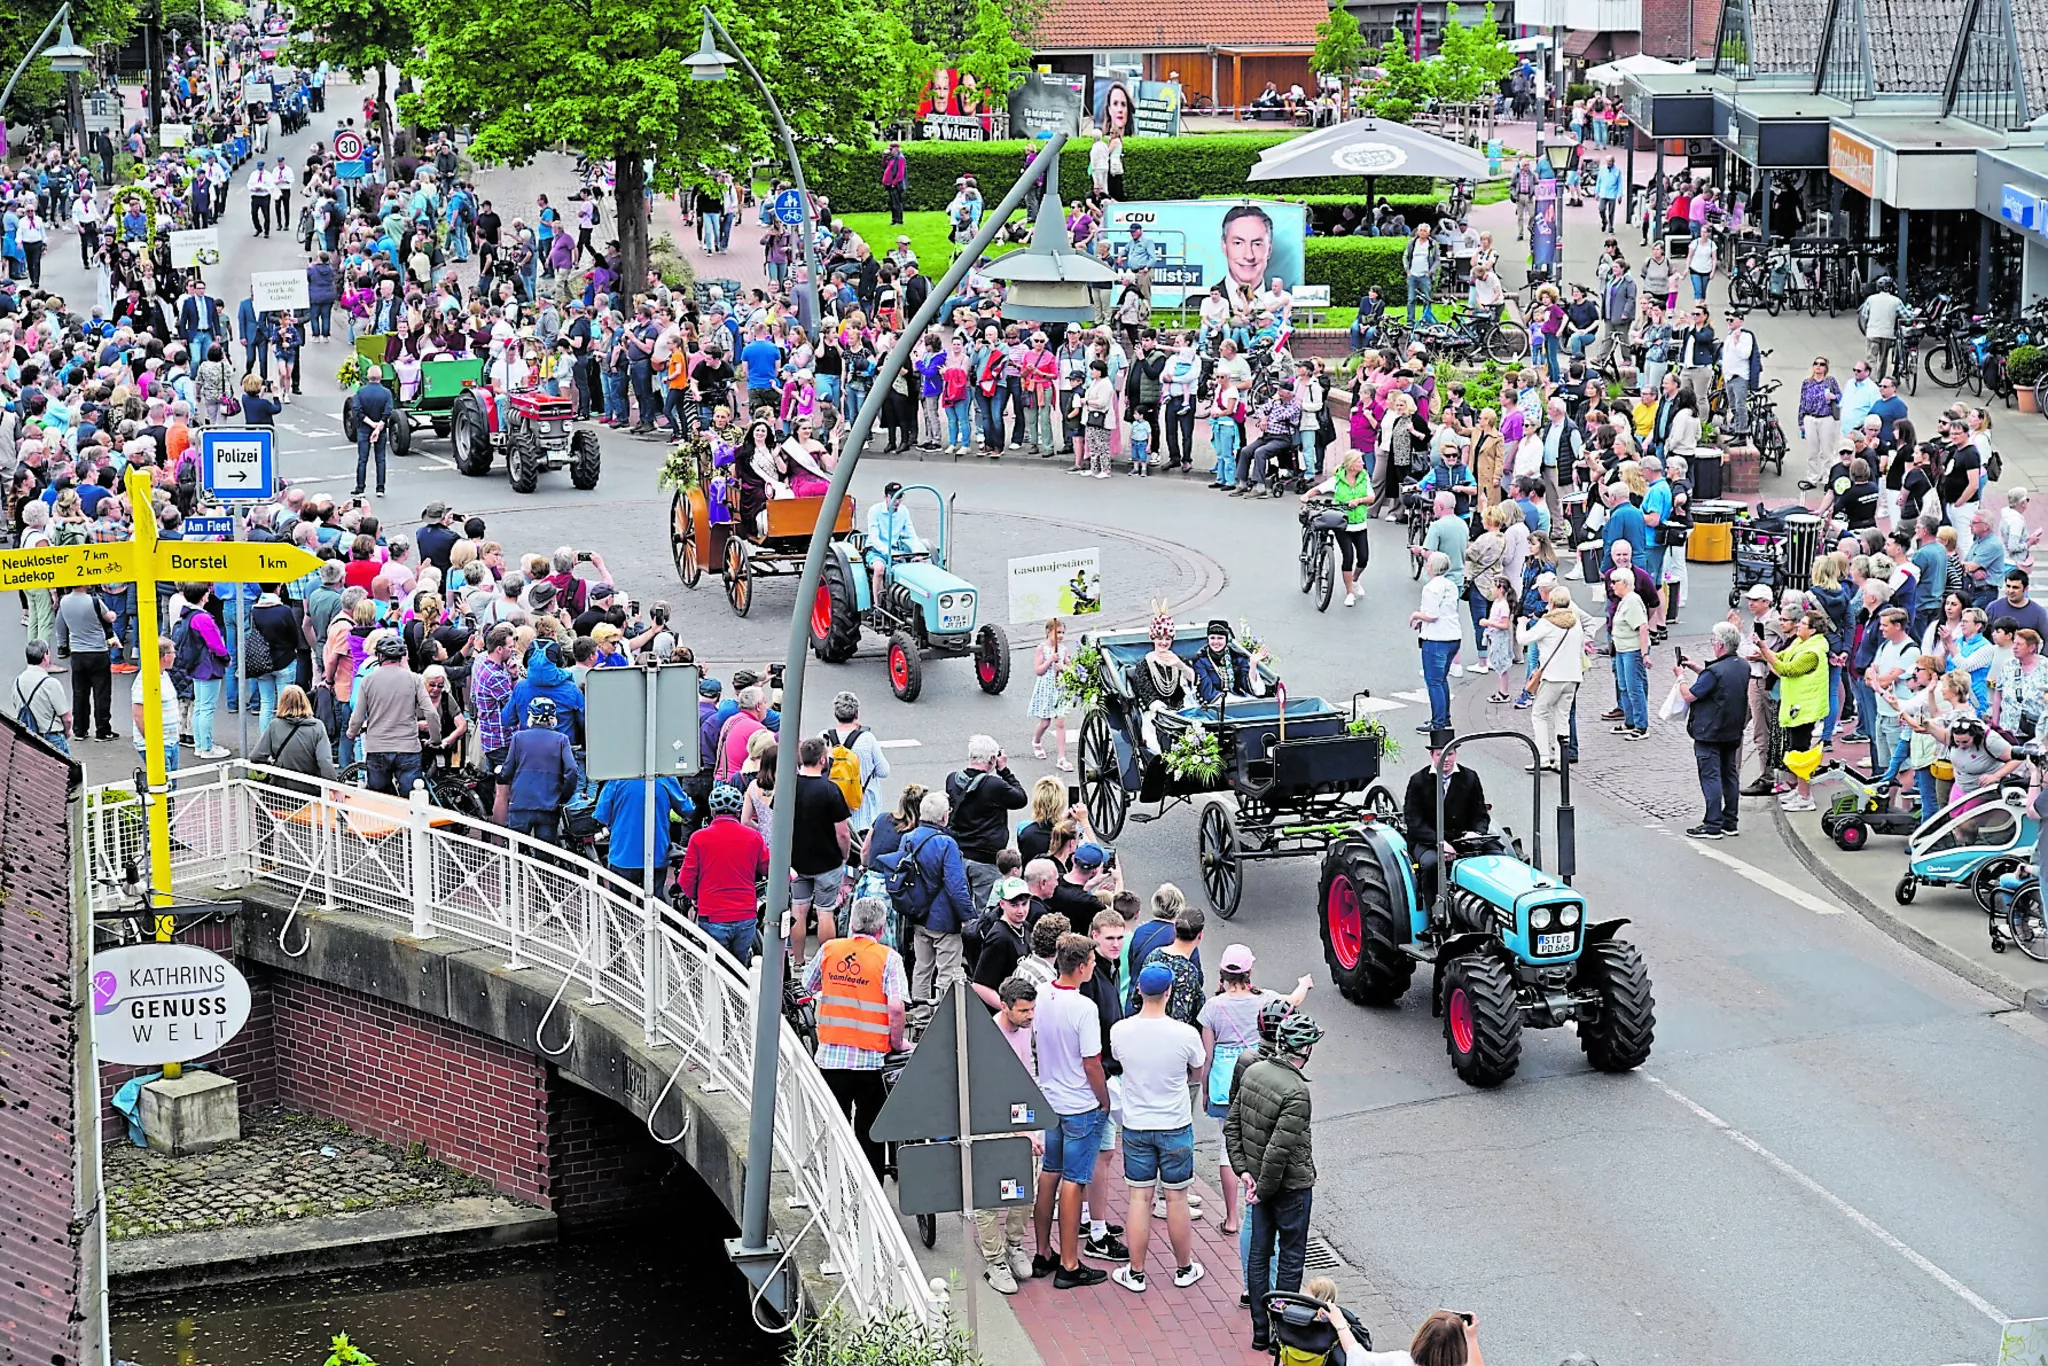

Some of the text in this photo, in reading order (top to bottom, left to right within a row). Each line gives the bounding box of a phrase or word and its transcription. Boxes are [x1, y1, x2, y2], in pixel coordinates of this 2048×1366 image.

[341, 140, 357, 153] 30
[1125, 212, 1155, 222] CDU
[217, 448, 258, 463] Polizei
[188, 520, 231, 532] Am Fleet
[2, 550, 108, 570] Neukloster 7 km
[171, 554, 227, 569] Borstel
[1014, 558, 1094, 576] Gastmajestäten
[4, 566, 102, 585] Ladekop 2 km
[1545, 936, 1562, 944] STD
[130, 964, 225, 987] KATHRINS
[828, 972, 870, 986] Teamleader
[131, 997, 227, 1019] GENUSS
[132, 1020, 227, 1044] WELT
